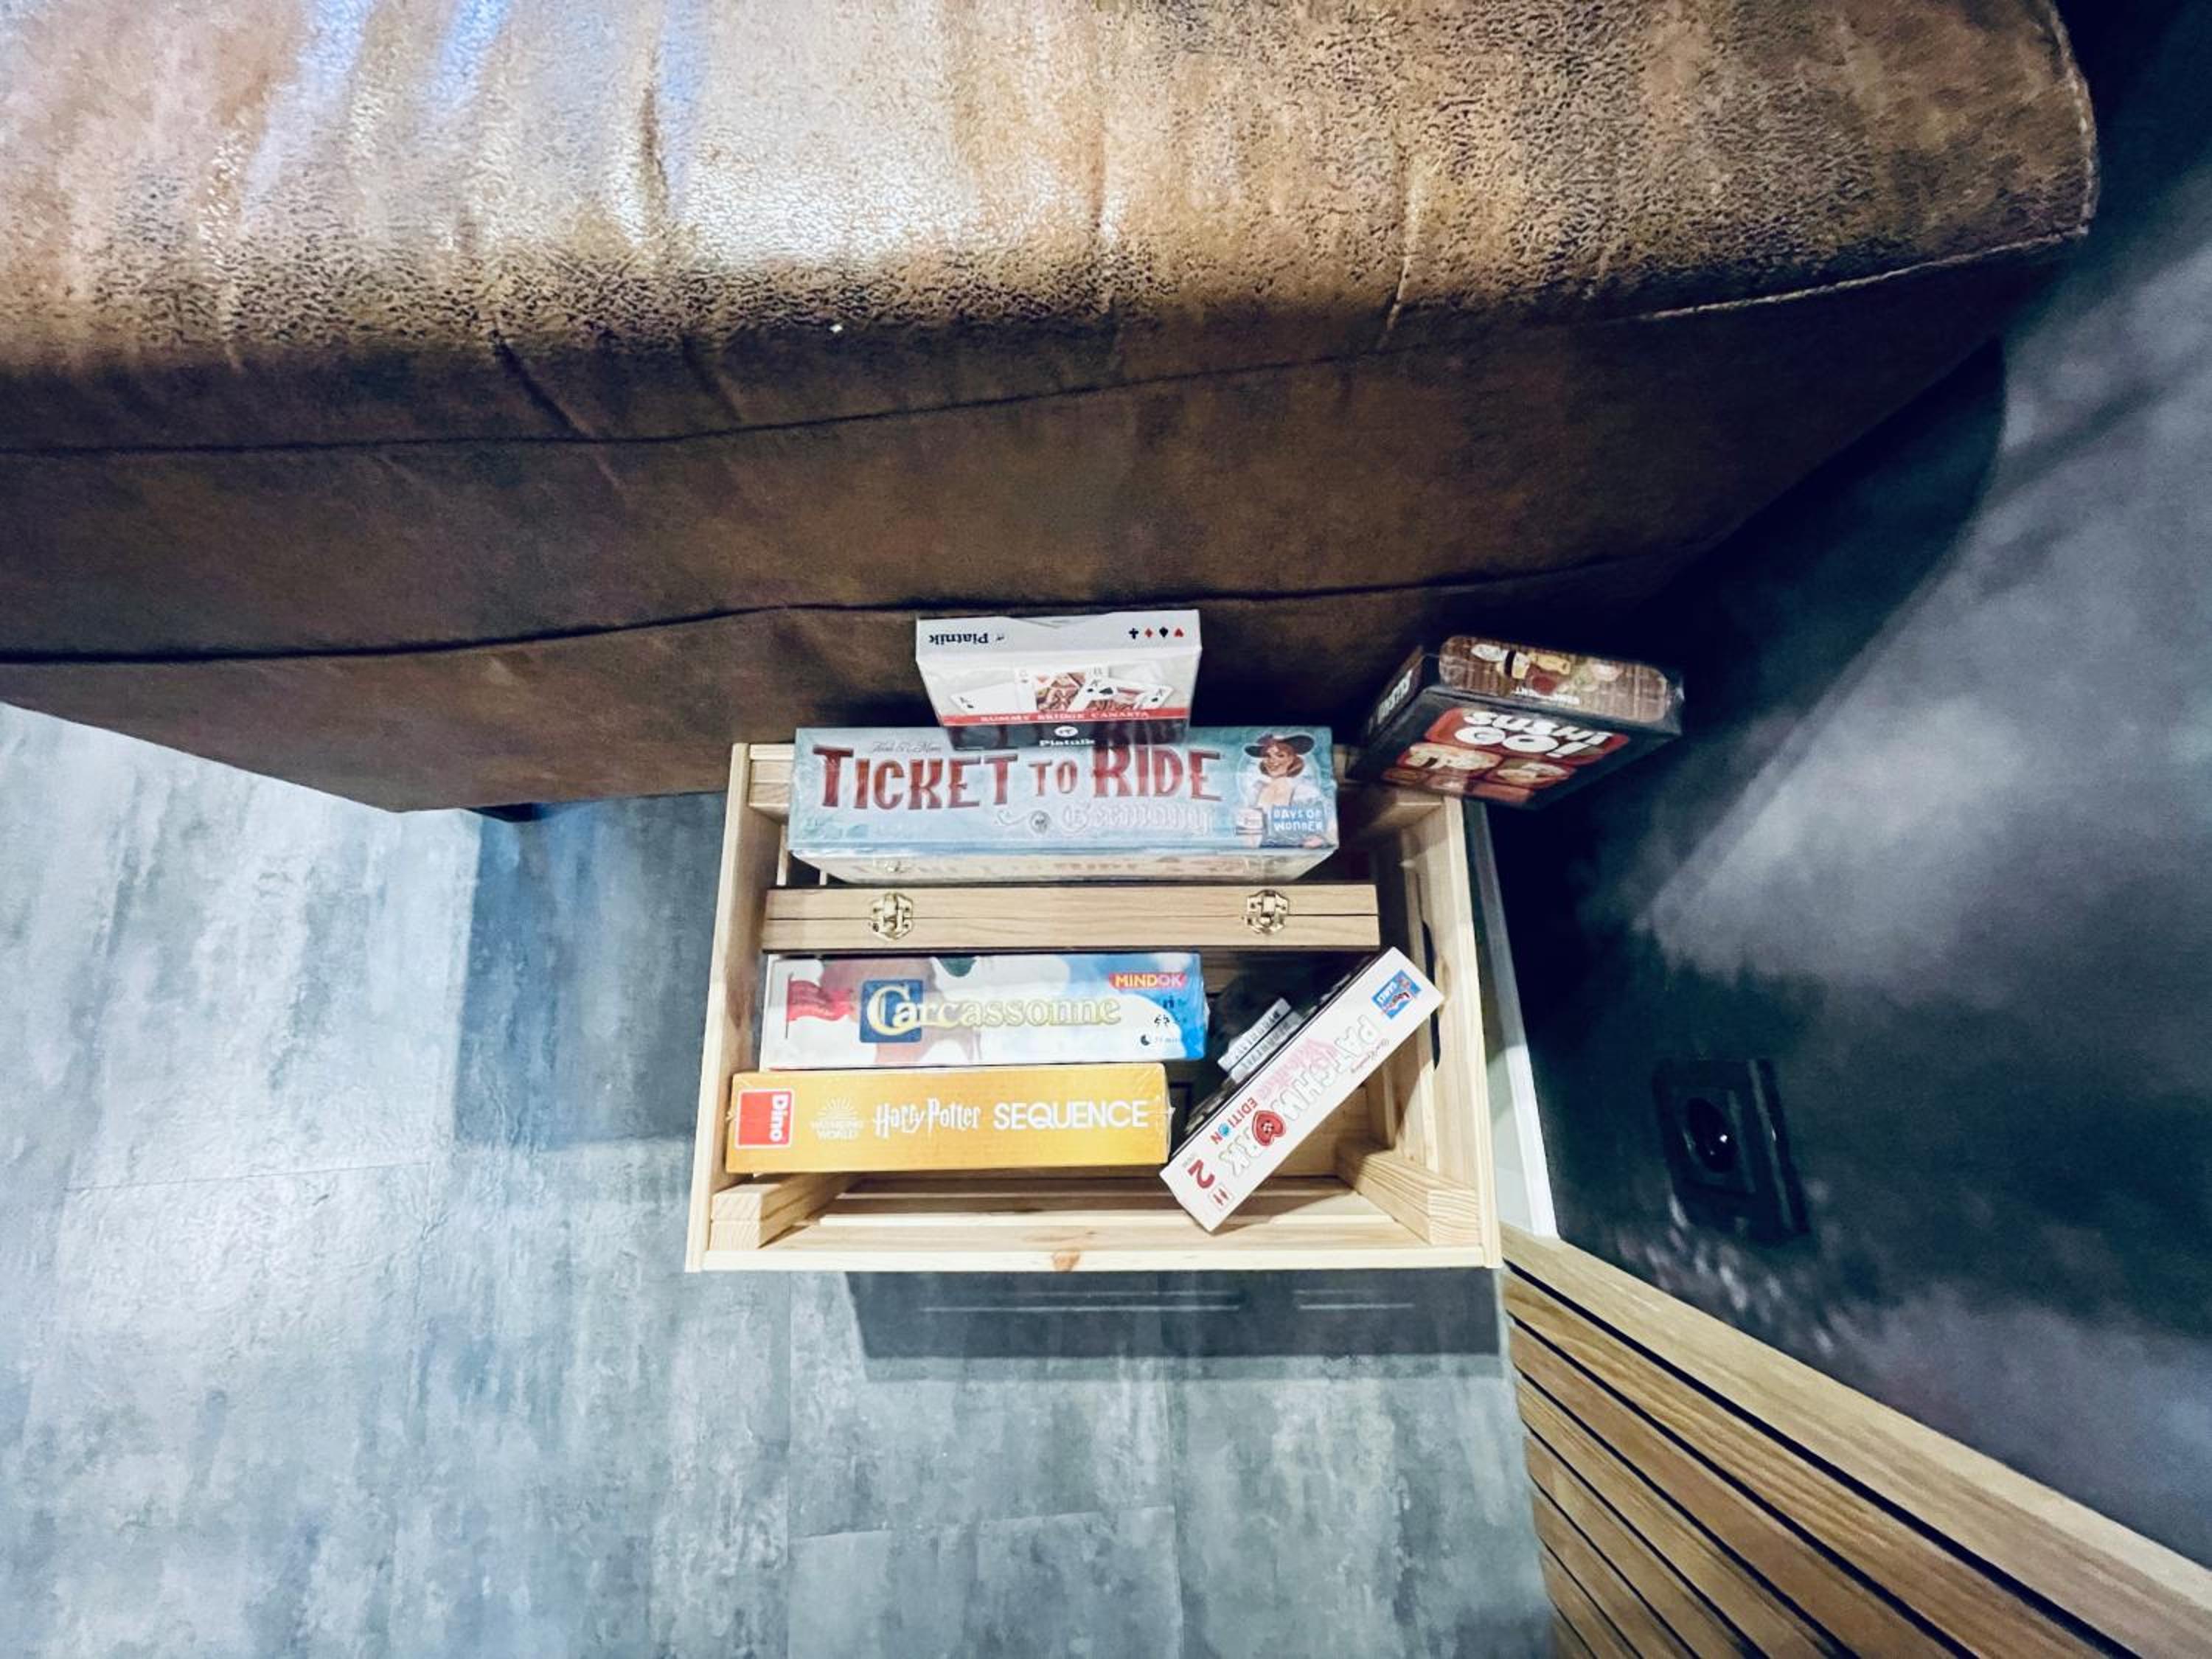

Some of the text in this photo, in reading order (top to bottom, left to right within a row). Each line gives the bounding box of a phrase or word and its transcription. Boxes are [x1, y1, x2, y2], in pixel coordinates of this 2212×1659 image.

[928, 632, 989, 645] Piatnik
[1455, 726, 1593, 759] GO!
[1463, 711, 1613, 746] SUSHI
[812, 743, 1222, 810] TICKET TO RIDE
[1273, 820, 1324, 832] WONDER
[1115, 973, 1184, 988] MINDOK
[866, 984, 1123, 1037] Carcassonne
[769, 1093, 790, 1143] Dino
[872, 1096, 981, 1139] Harry Potter
[993, 1100, 1150, 1130] SEQUENCE
[1186, 1158, 1217, 1189] 2
